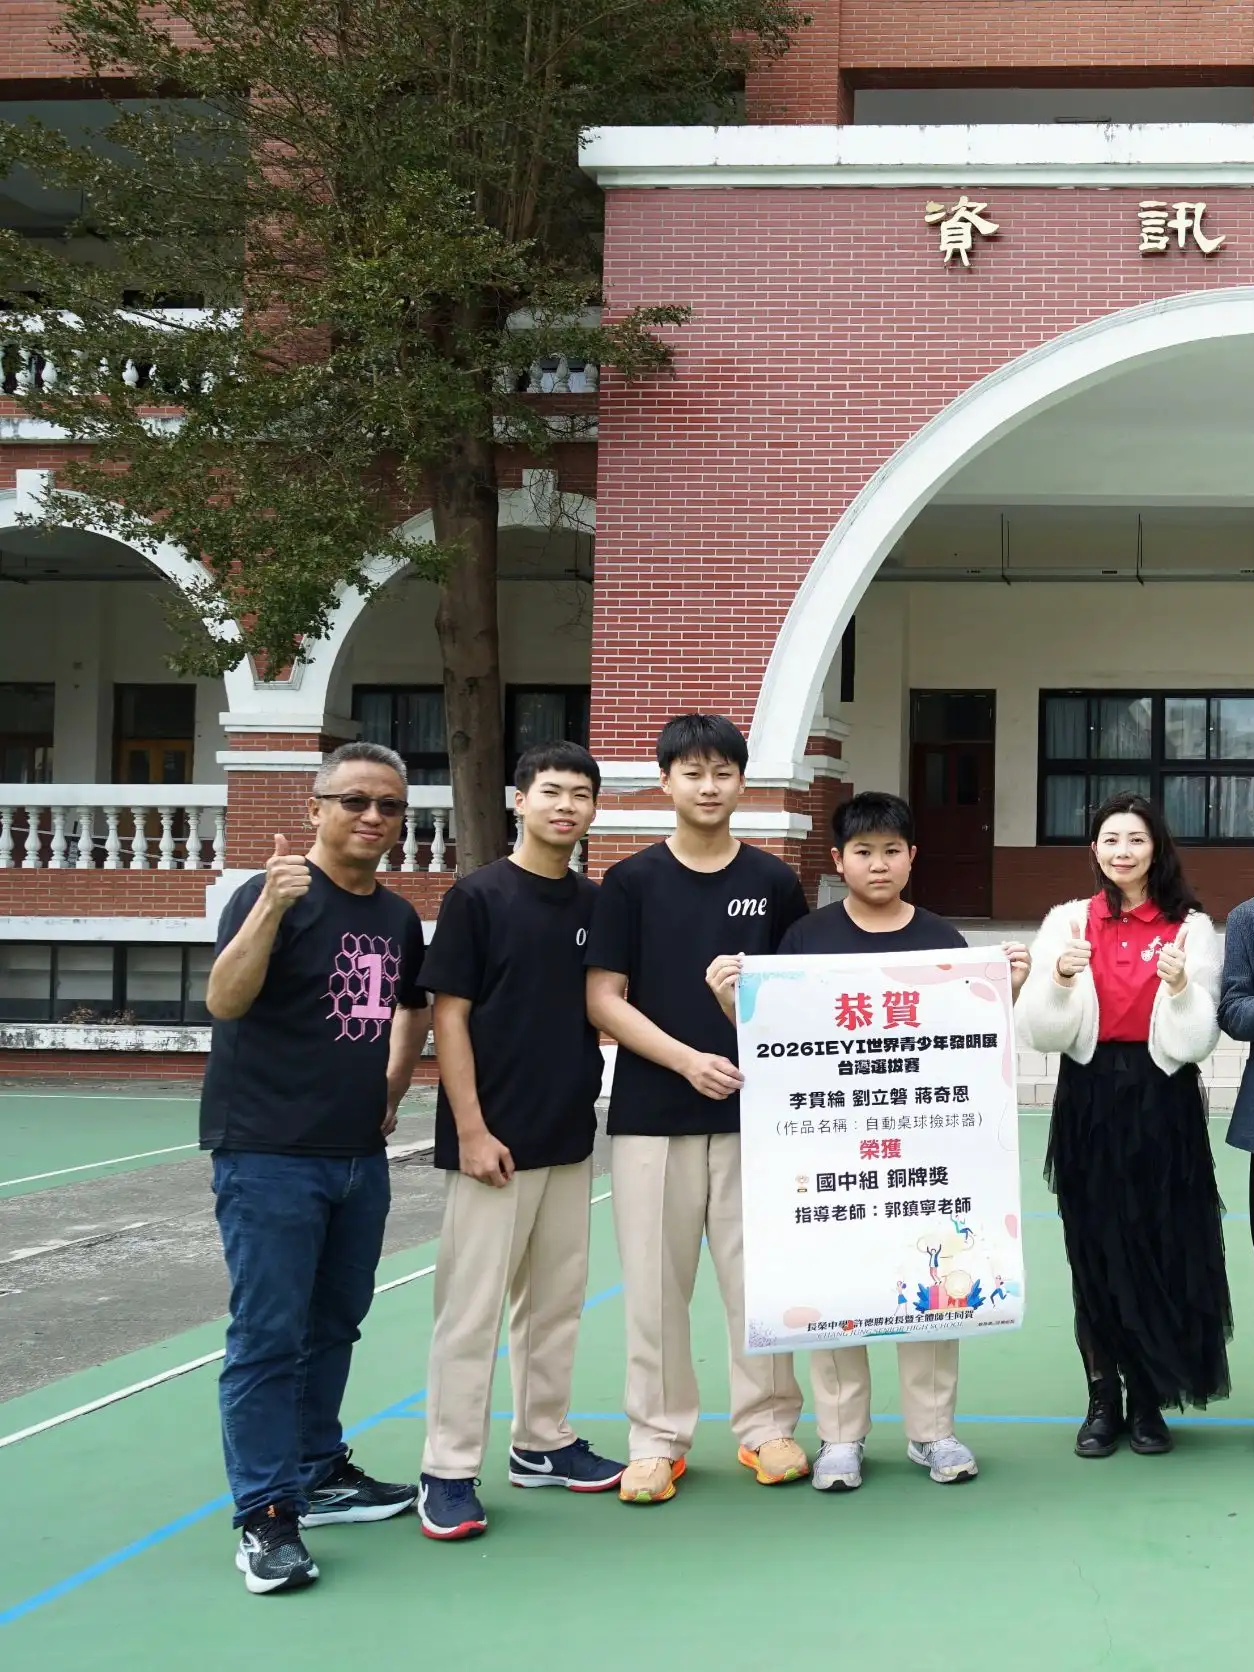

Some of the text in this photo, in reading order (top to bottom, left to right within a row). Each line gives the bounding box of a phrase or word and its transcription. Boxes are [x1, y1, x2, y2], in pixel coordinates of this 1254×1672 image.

[727, 897, 768, 917] one
[834, 990, 922, 1031] 恭賀
[756, 1033, 998, 1058] 2026IEYI世界青少年發明展
[838, 1057, 920, 1076] 台灣選拔賽
[852, 1088, 908, 1107] 劉立磐
[914, 1085, 970, 1105] 蔣奇恩
[859, 1138, 902, 1160] 榮獲
[816, 1166, 949, 1193] 國中組 銅牌獎
